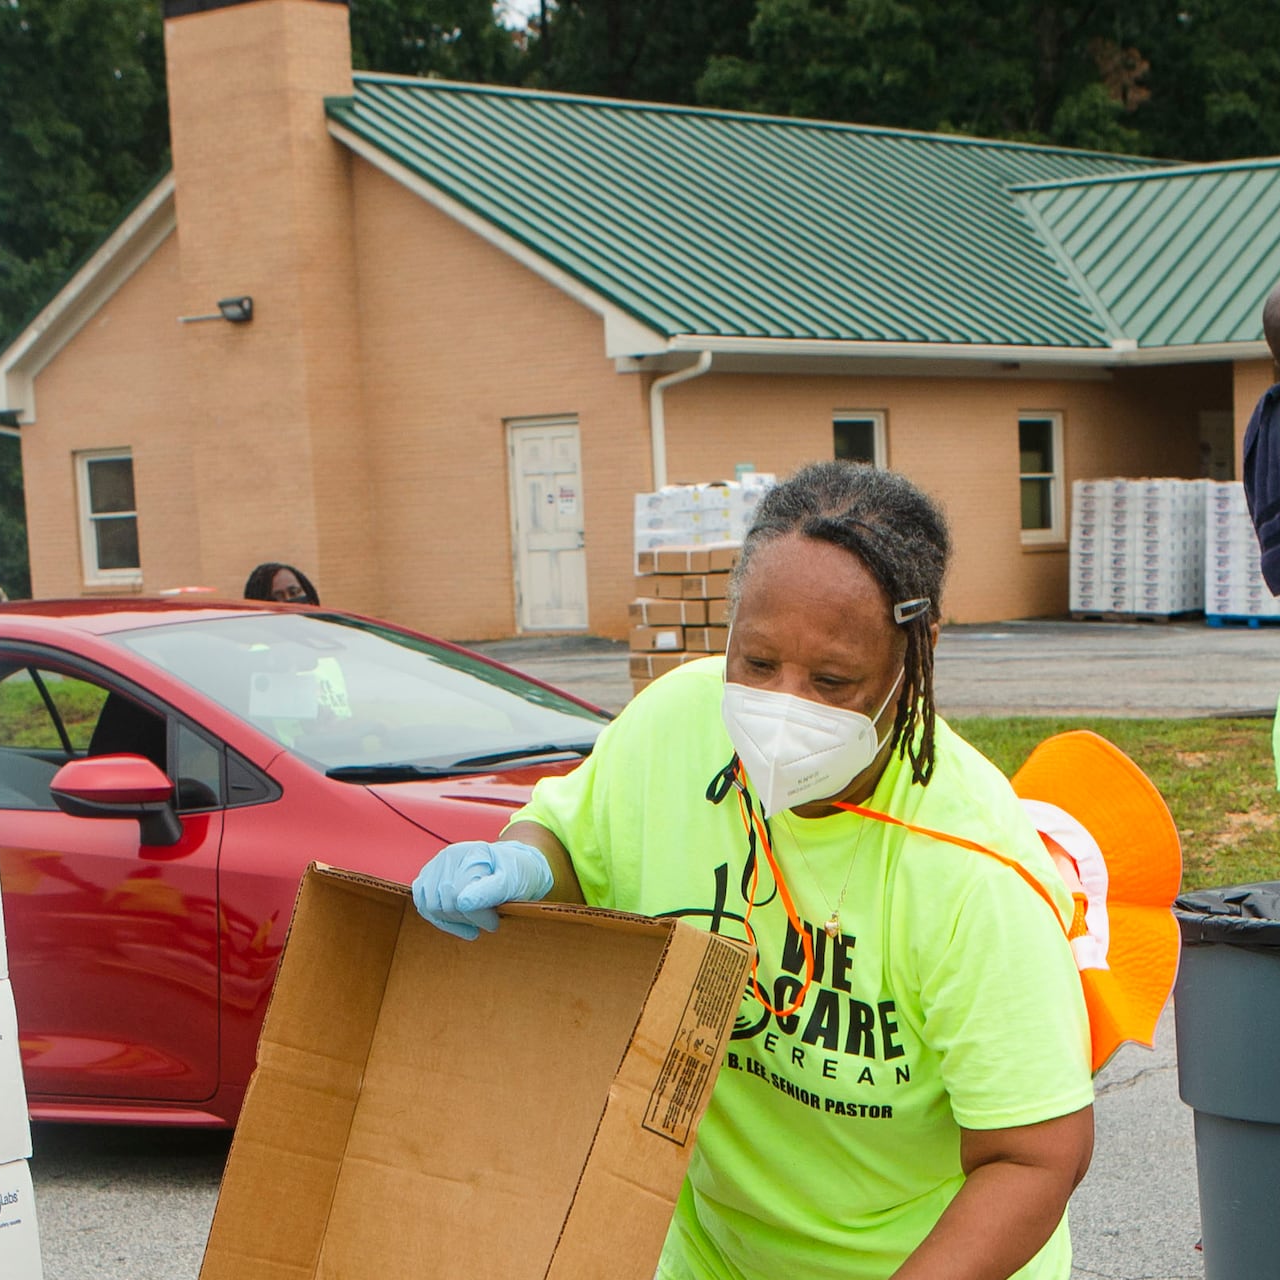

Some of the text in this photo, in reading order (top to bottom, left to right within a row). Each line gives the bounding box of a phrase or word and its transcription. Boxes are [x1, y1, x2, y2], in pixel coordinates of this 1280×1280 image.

[782, 917, 856, 993] WE
[773, 976, 905, 1060] CARE
[728, 1052, 893, 1119] B. LEE, SENIOR PASTOR
[764, 1032, 911, 1086] EREAN
